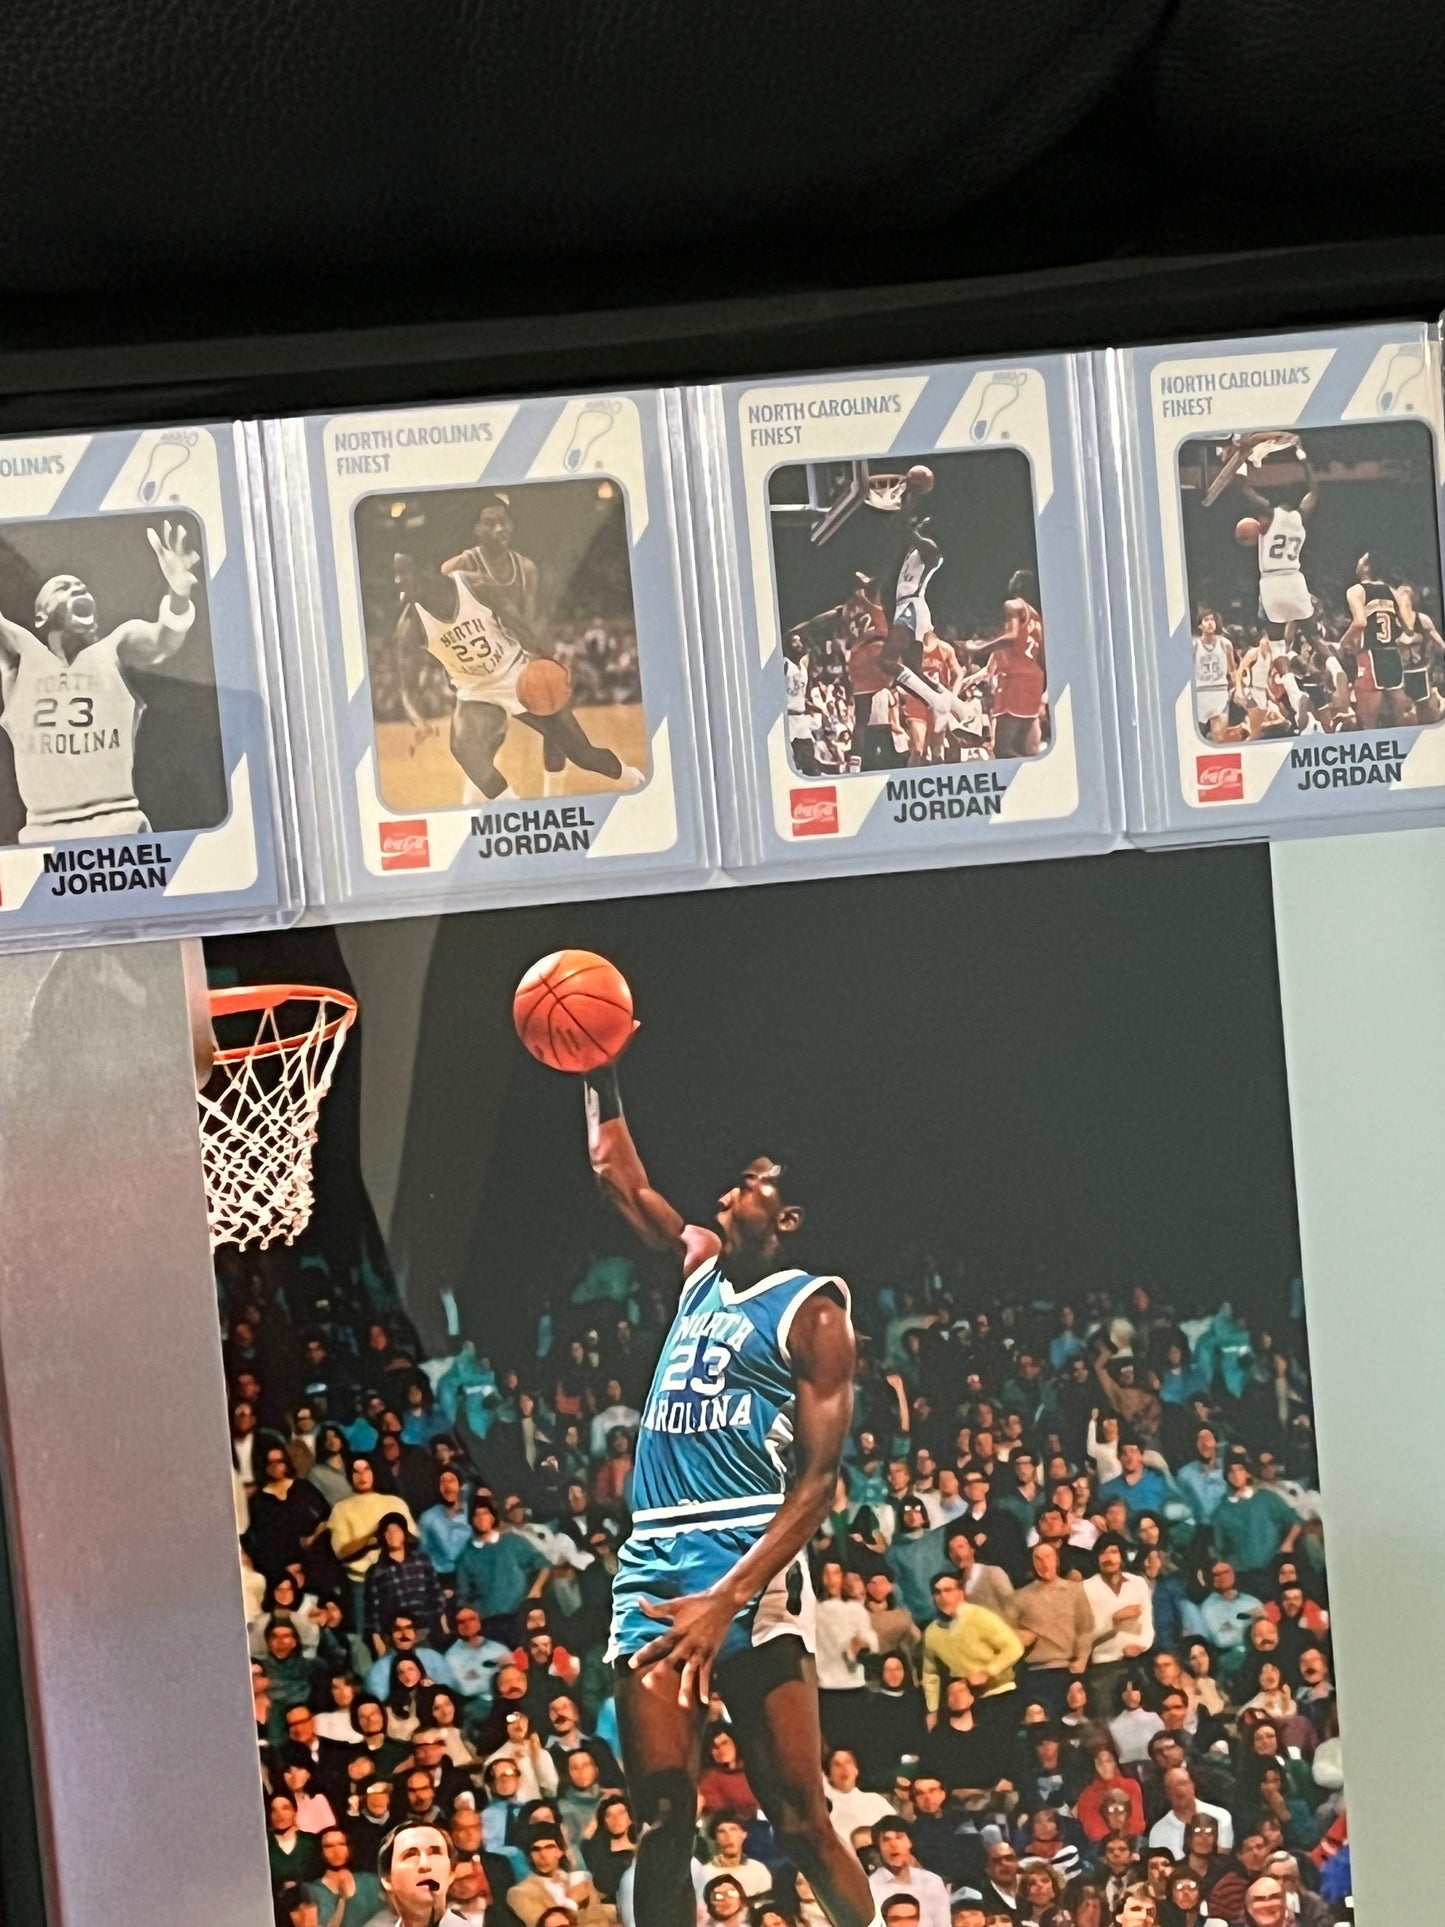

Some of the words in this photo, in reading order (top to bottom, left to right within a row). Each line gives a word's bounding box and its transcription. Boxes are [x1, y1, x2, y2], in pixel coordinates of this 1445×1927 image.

[1161, 373, 1216, 396] NORTH
[1218, 366, 1311, 391] CAROLINA'S
[748, 404, 805, 424] NORTH
[808, 394, 902, 419] CAROLINA'S
[1162, 396, 1213, 418] FINEST
[334, 429, 393, 452] NORTH
[396, 422, 494, 447] CAROLINA'S
[750, 425, 802, 447] FINEST
[336, 453, 391, 476] FINEST
[451, 636, 492, 663] 23
[33, 697, 94, 728] 23
[1290, 740, 1409, 769] MICHAEL
[886, 771, 1007, 801] MICHAEL
[1297, 762, 1403, 791] JORDAN
[470, 806, 595, 836] MICHAEL
[893, 795, 1002, 823] JORDAN
[43, 843, 172, 873] MICHAEL
[478, 829, 591, 859] JORDAN
[51, 866, 168, 896] JORDAN
[659, 1345, 732, 1396] 23
